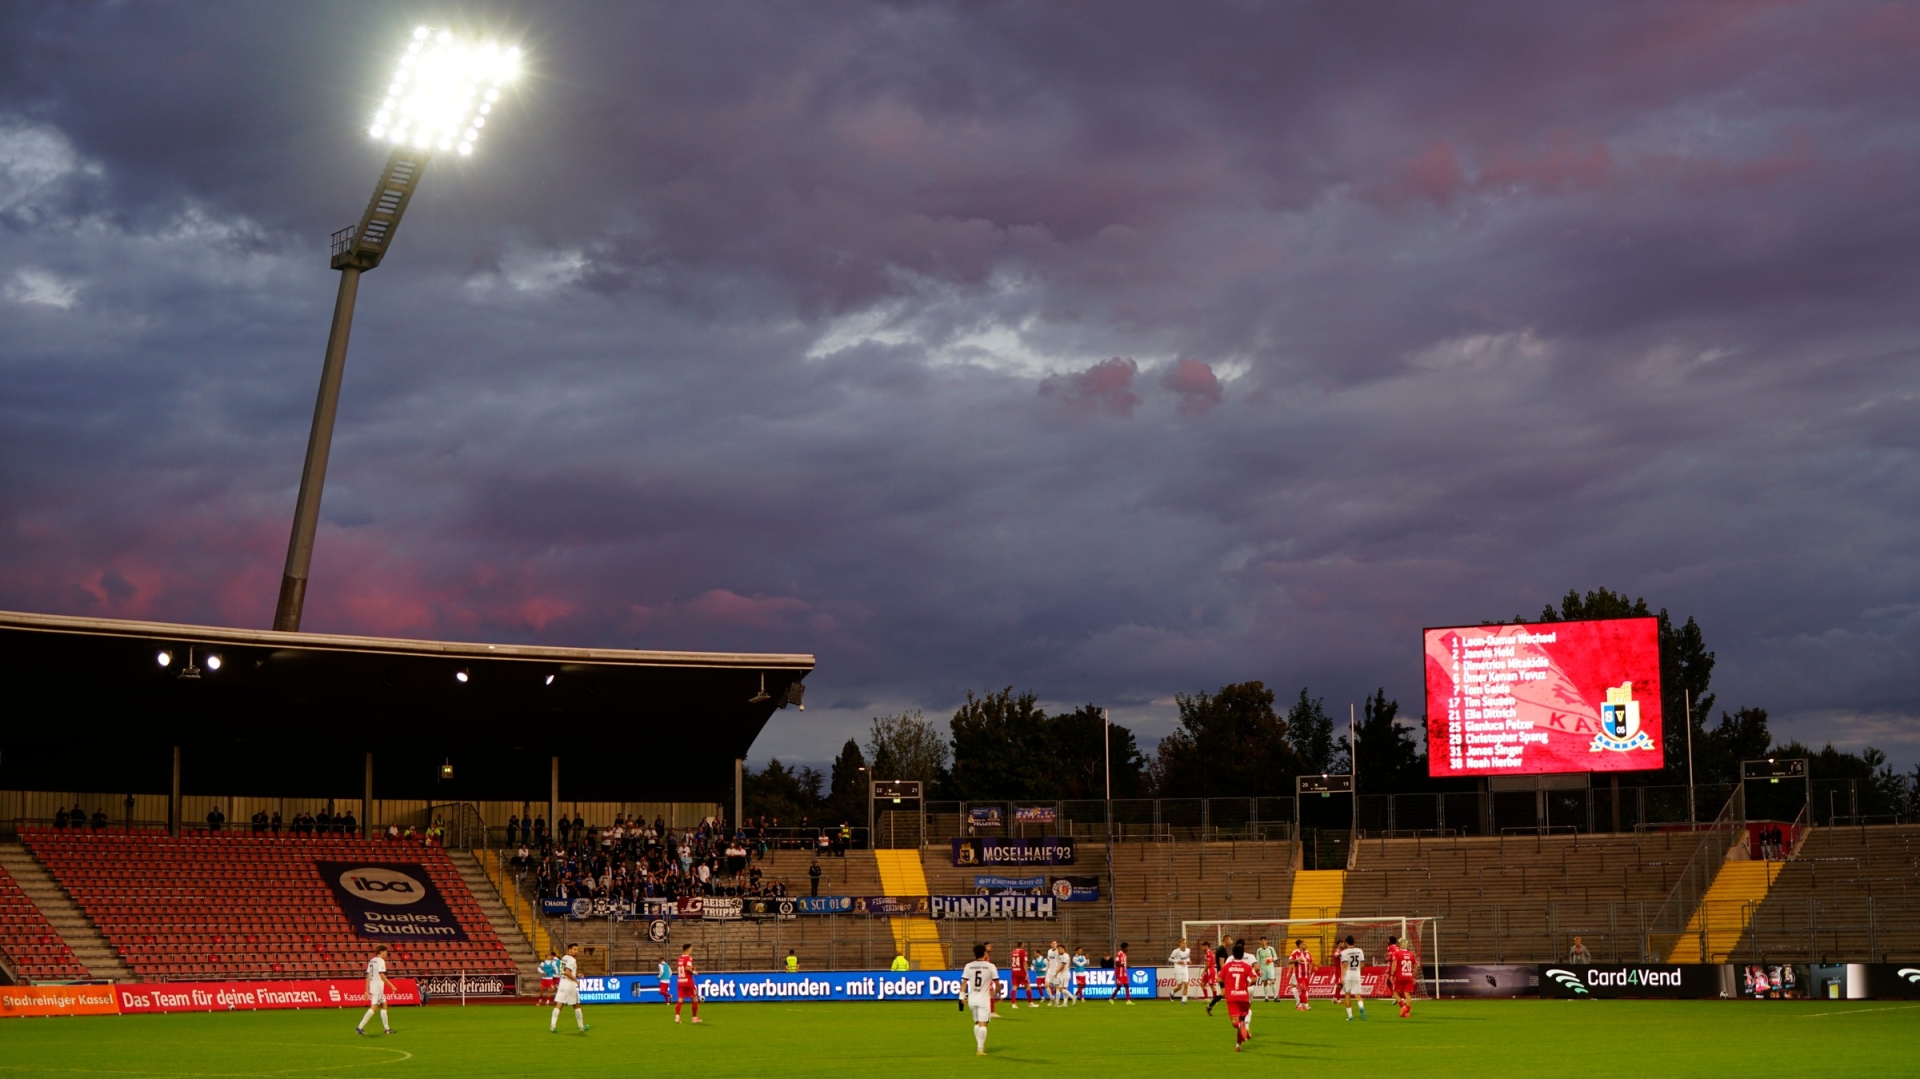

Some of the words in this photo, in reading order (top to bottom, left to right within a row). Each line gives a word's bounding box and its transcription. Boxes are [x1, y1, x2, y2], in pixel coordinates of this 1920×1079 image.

[1452, 637, 1459, 647] 1
[1518, 632, 1556, 644] Wechsel
[1452, 649, 1459, 659] 2
[1463, 648, 1493, 659] Jannis
[1494, 646, 1515, 657] Held
[1452, 661, 1459, 671] 4
[1452, 673, 1459, 684] 6
[1488, 671, 1518, 683] Kenan
[1519, 670, 1547, 680] Yavuz
[1453, 685, 1460, 695] 7
[1464, 685, 1482, 695] Tom
[1448, 697, 1460, 708] 17
[1464, 697, 1480, 707] Tim
[1448, 709, 1460, 720] 21
[1483, 707, 1516, 719] Dittrich
[1449, 722, 1461, 732] 25
[1465, 720, 1504, 732] Gianluca
[1505, 719, 1534, 730] Pelzer
[1465, 733, 1518, 746] Christopher
[1519, 731, 1549, 745] Spang
[1450, 746, 1462, 757] 31
[1466, 746, 1493, 757] Jonas
[1494, 744, 1524, 758] Singer
[1466, 758, 1490, 769] Noah
[1492, 757, 1523, 768] Herber
[350, 876, 415, 893] iba
[702, 898, 731, 907] REISE
[811, 898, 826, 910] SCT
[829, 898, 839, 909] 01
[931, 895, 1054, 918] PÜNDERICH
[363, 911, 441, 923] Duales
[703, 907, 742, 917] TRUPPE
[363, 923, 457, 935] Studium
[1012, 956, 1021, 968] 24
[1349, 955, 1360, 968] 25
[1401, 960, 1412, 973] 20
[677, 965, 686, 978] 13
[1587, 968, 1681, 986] Card4Vend
[975, 970, 982, 988] 6
[1232, 973, 1241, 991] 7
[695, 979, 736, 997] rfekt
[739, 977, 831, 996] verbunden
[846, 977, 875, 996] mit
[878, 977, 924, 1000] jeder
[3, 995, 76, 1008] Stadtreiniger
[78, 993, 114, 1005] Kassel
[122, 991, 149, 1008] Das
[150, 990, 191, 1007] Team
[192, 989, 214, 1006] für
[217, 987, 254, 1005] deine
[256, 987, 322, 1004] Finanzen.
